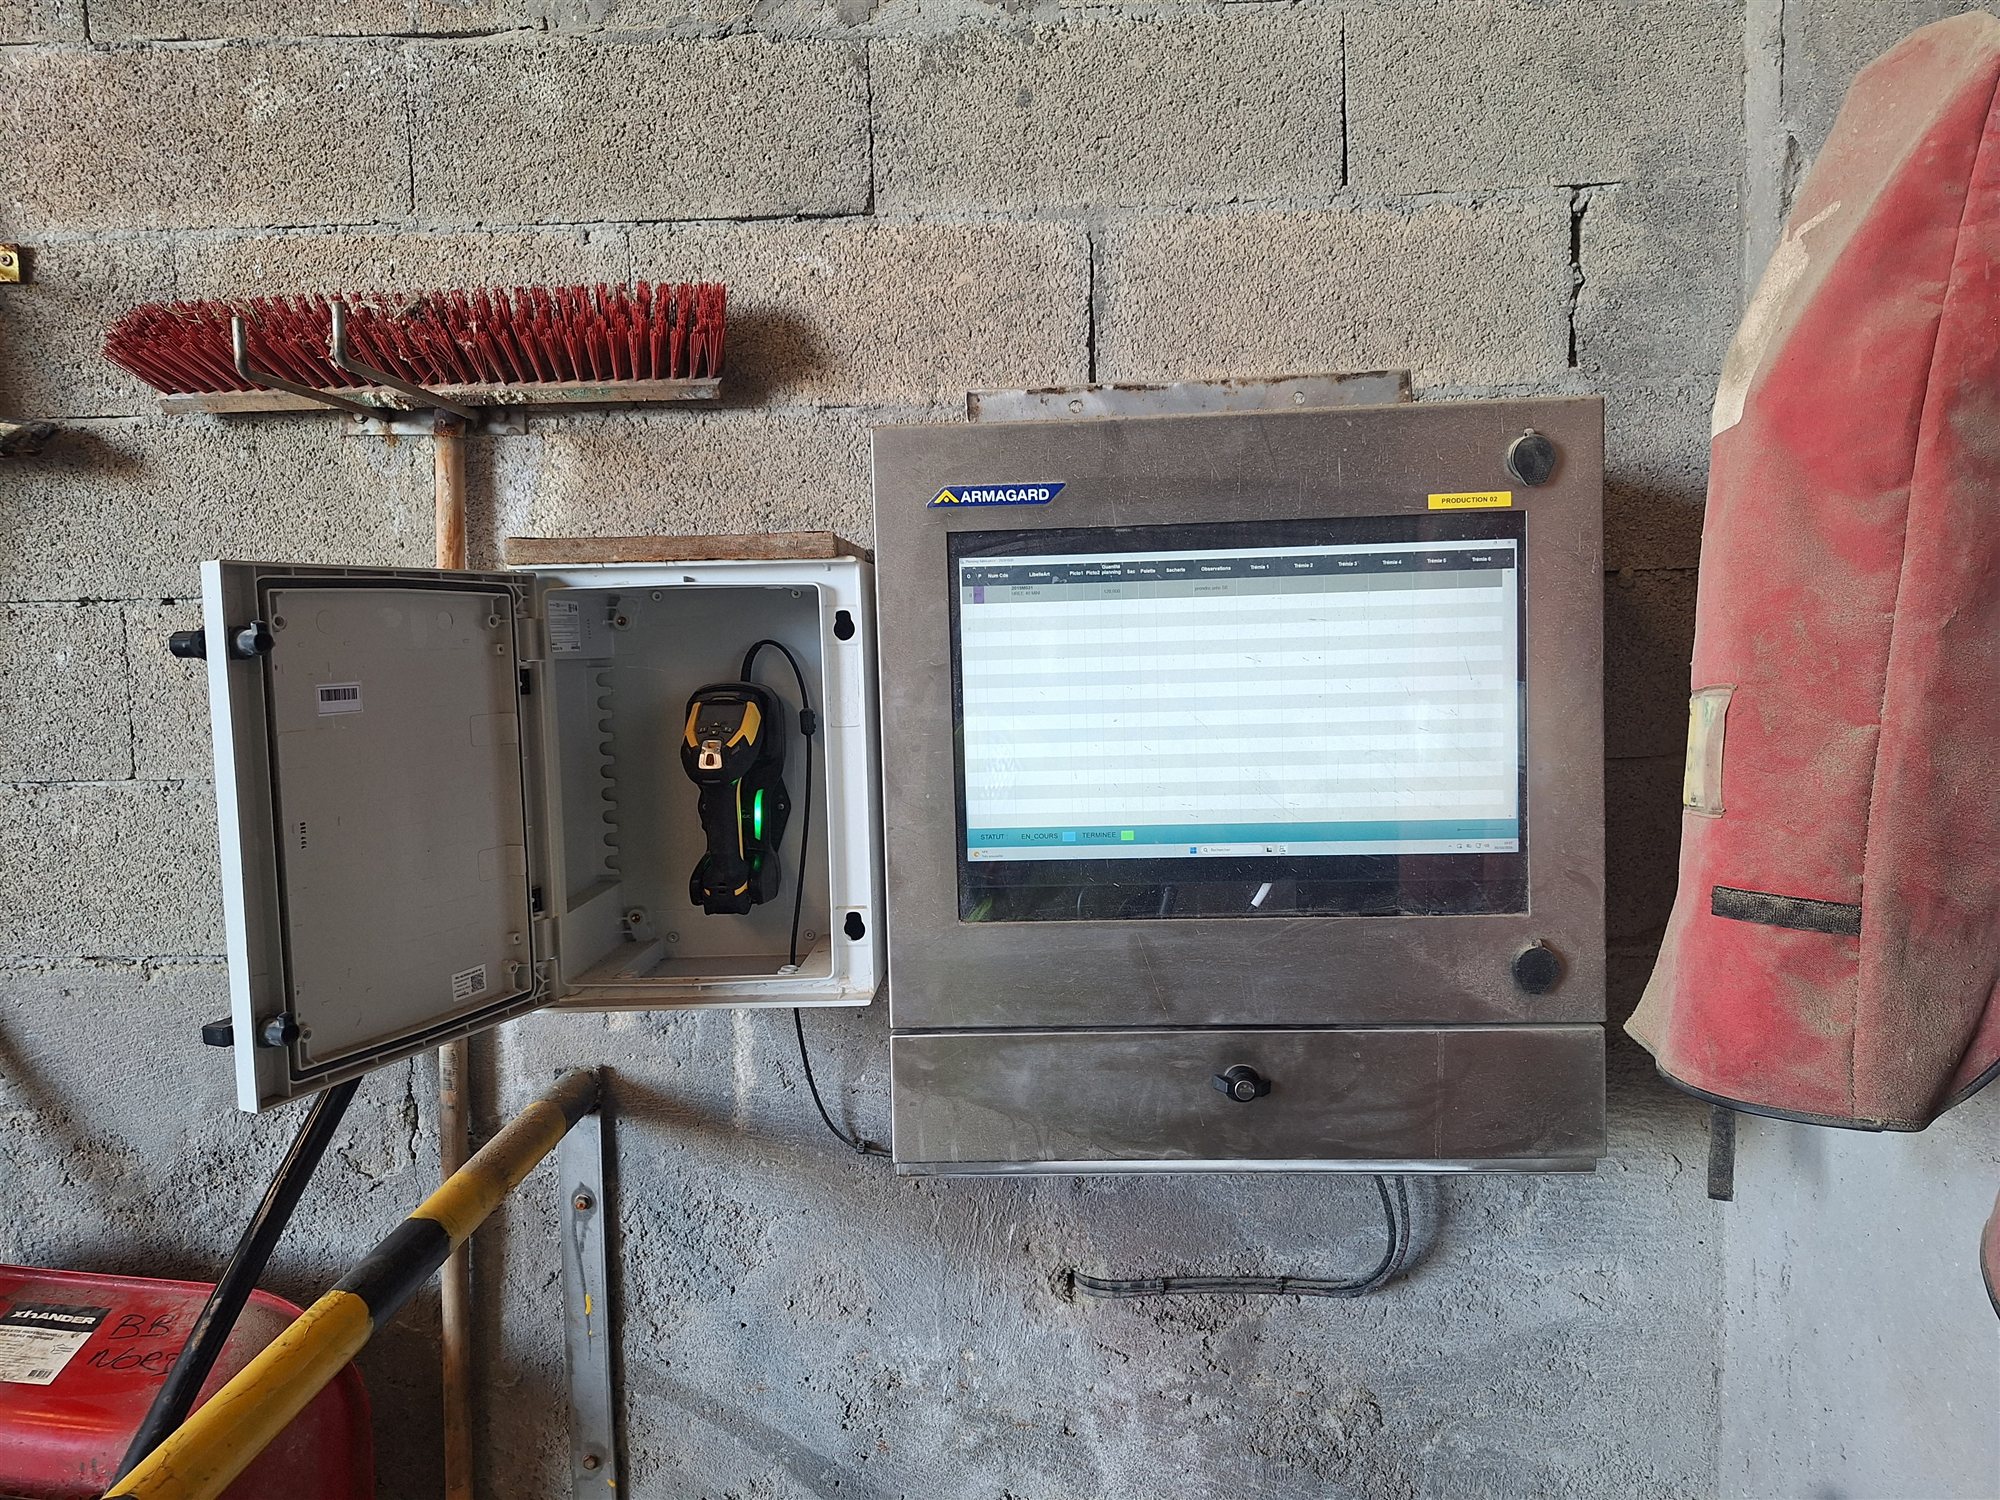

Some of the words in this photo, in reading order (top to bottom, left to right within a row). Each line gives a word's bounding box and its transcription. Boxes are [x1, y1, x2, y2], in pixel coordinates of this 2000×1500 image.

[961, 488, 1050, 503] ARMAGARD
[1441, 496, 1488, 504] PRODUCTION
[1021, 833, 1058, 841] EN_COURS
